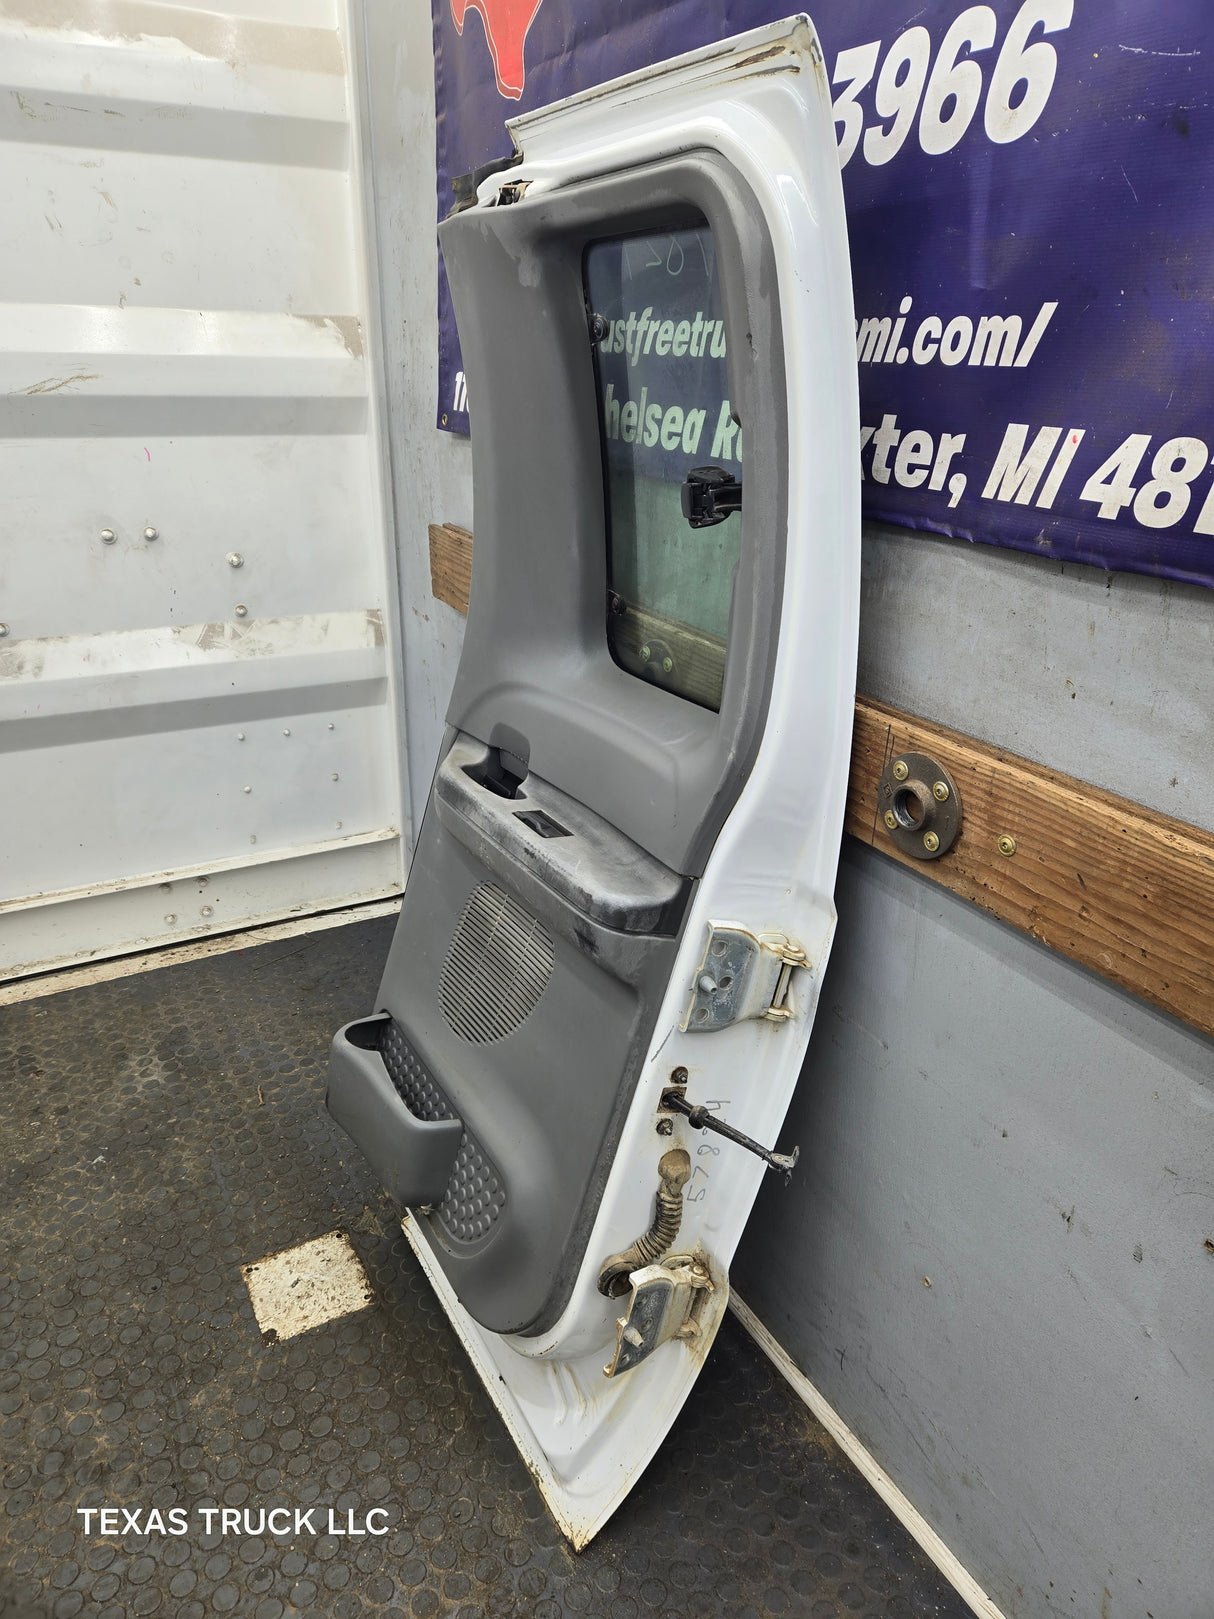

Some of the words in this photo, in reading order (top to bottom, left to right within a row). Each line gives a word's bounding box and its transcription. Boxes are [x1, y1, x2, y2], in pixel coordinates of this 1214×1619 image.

[832, 0, 1074, 170] 3966
[855, 296, 1058, 367] mi.com/
[453, 372, 469, 413] 11
[605, 384, 706, 454] helsea
[981, 423, 1086, 509] MI
